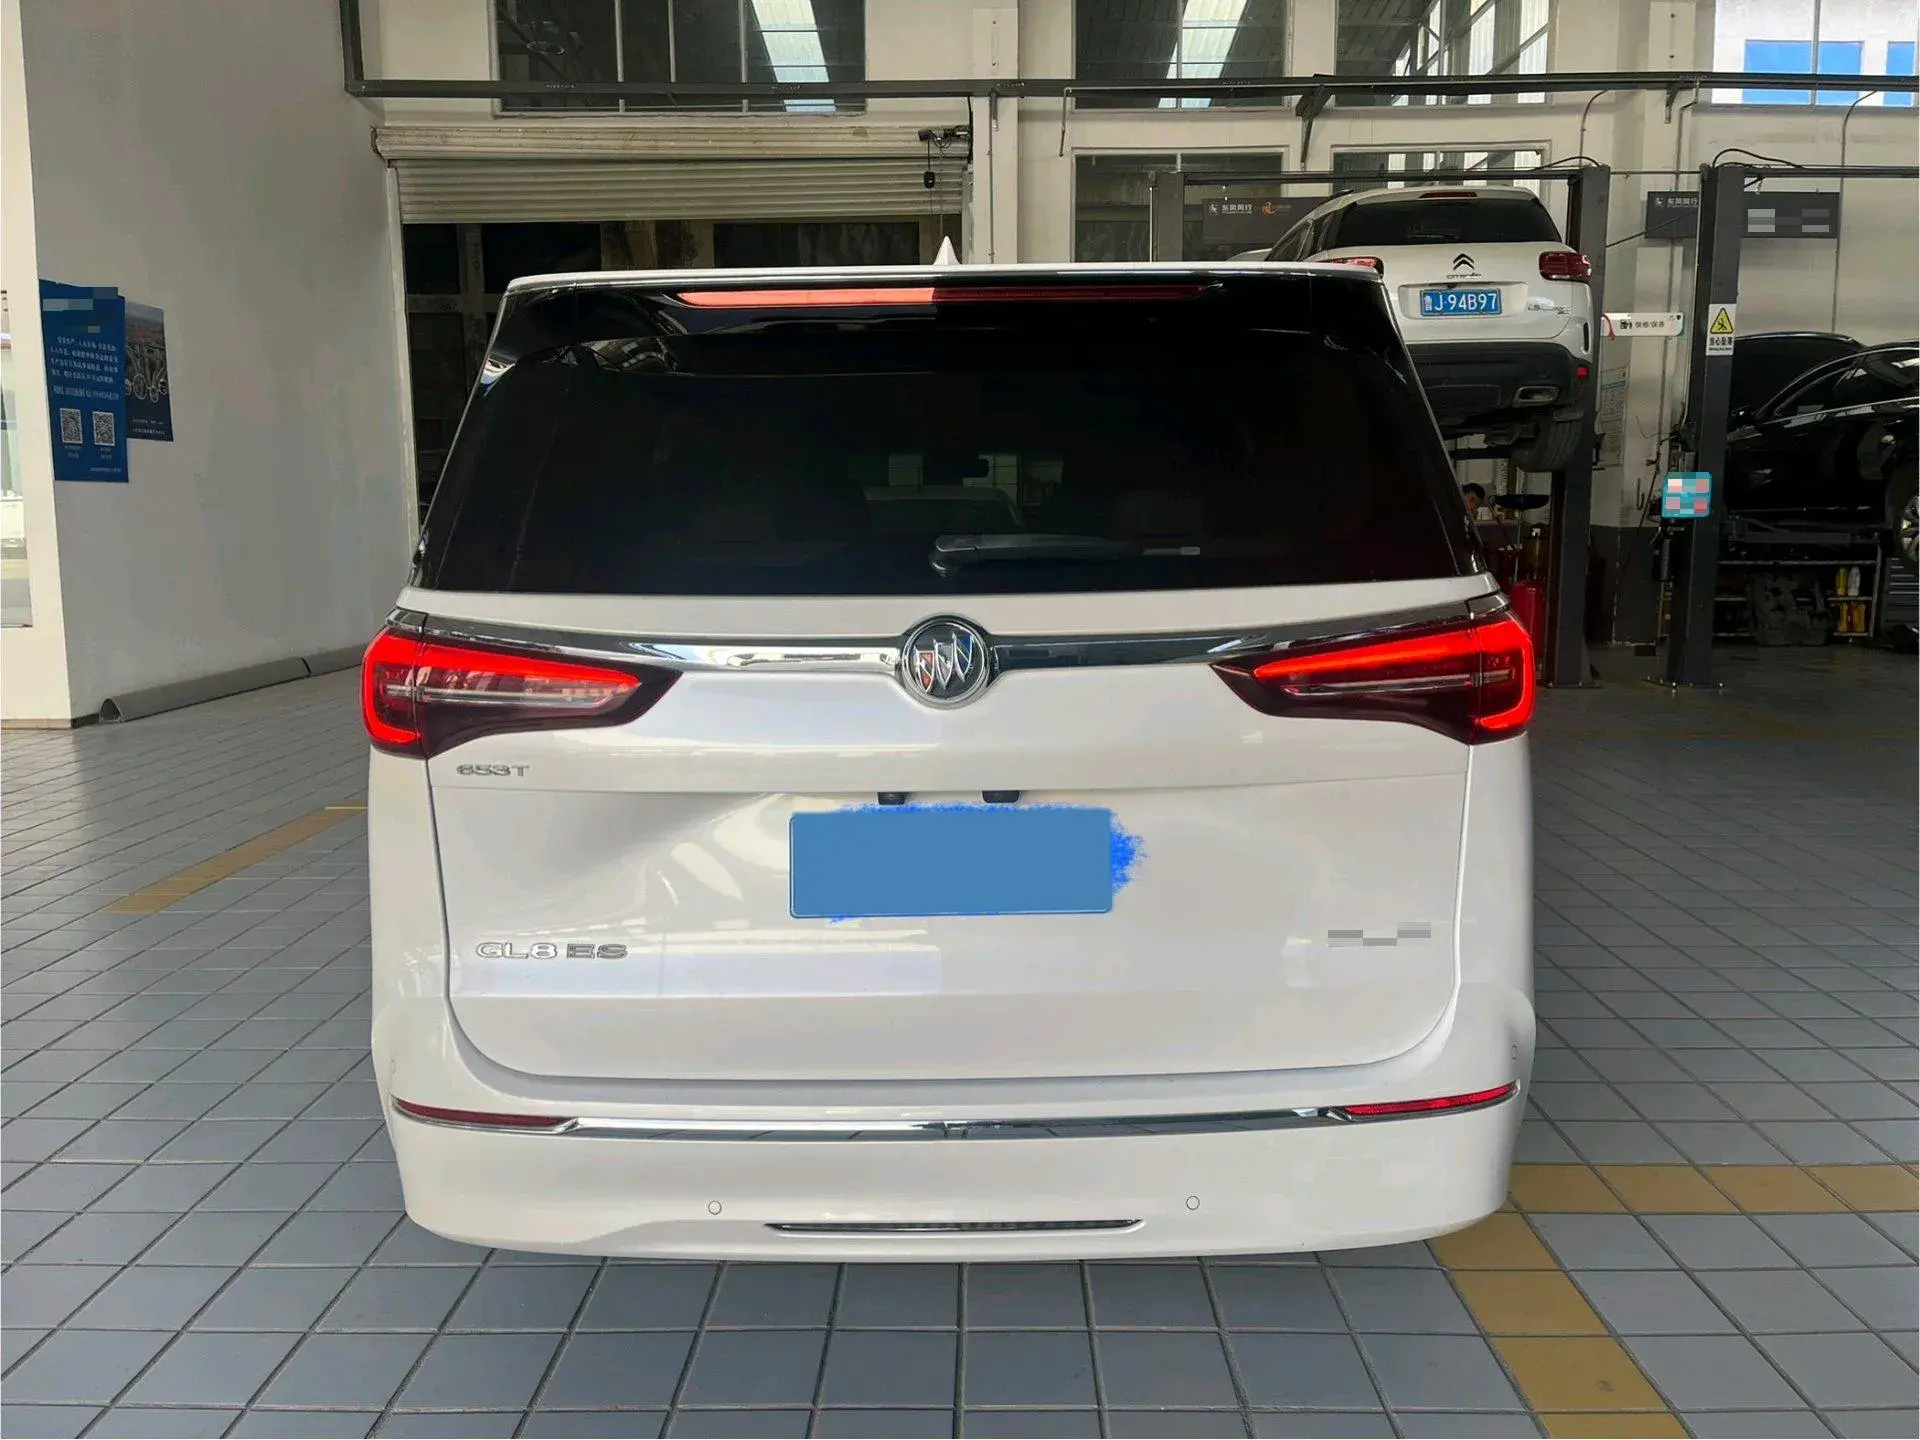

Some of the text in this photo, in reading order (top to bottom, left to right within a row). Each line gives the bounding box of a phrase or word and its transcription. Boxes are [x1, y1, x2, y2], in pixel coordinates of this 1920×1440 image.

[456, 763, 530, 777] 653T
[475, 941, 628, 960] GL8 ES
